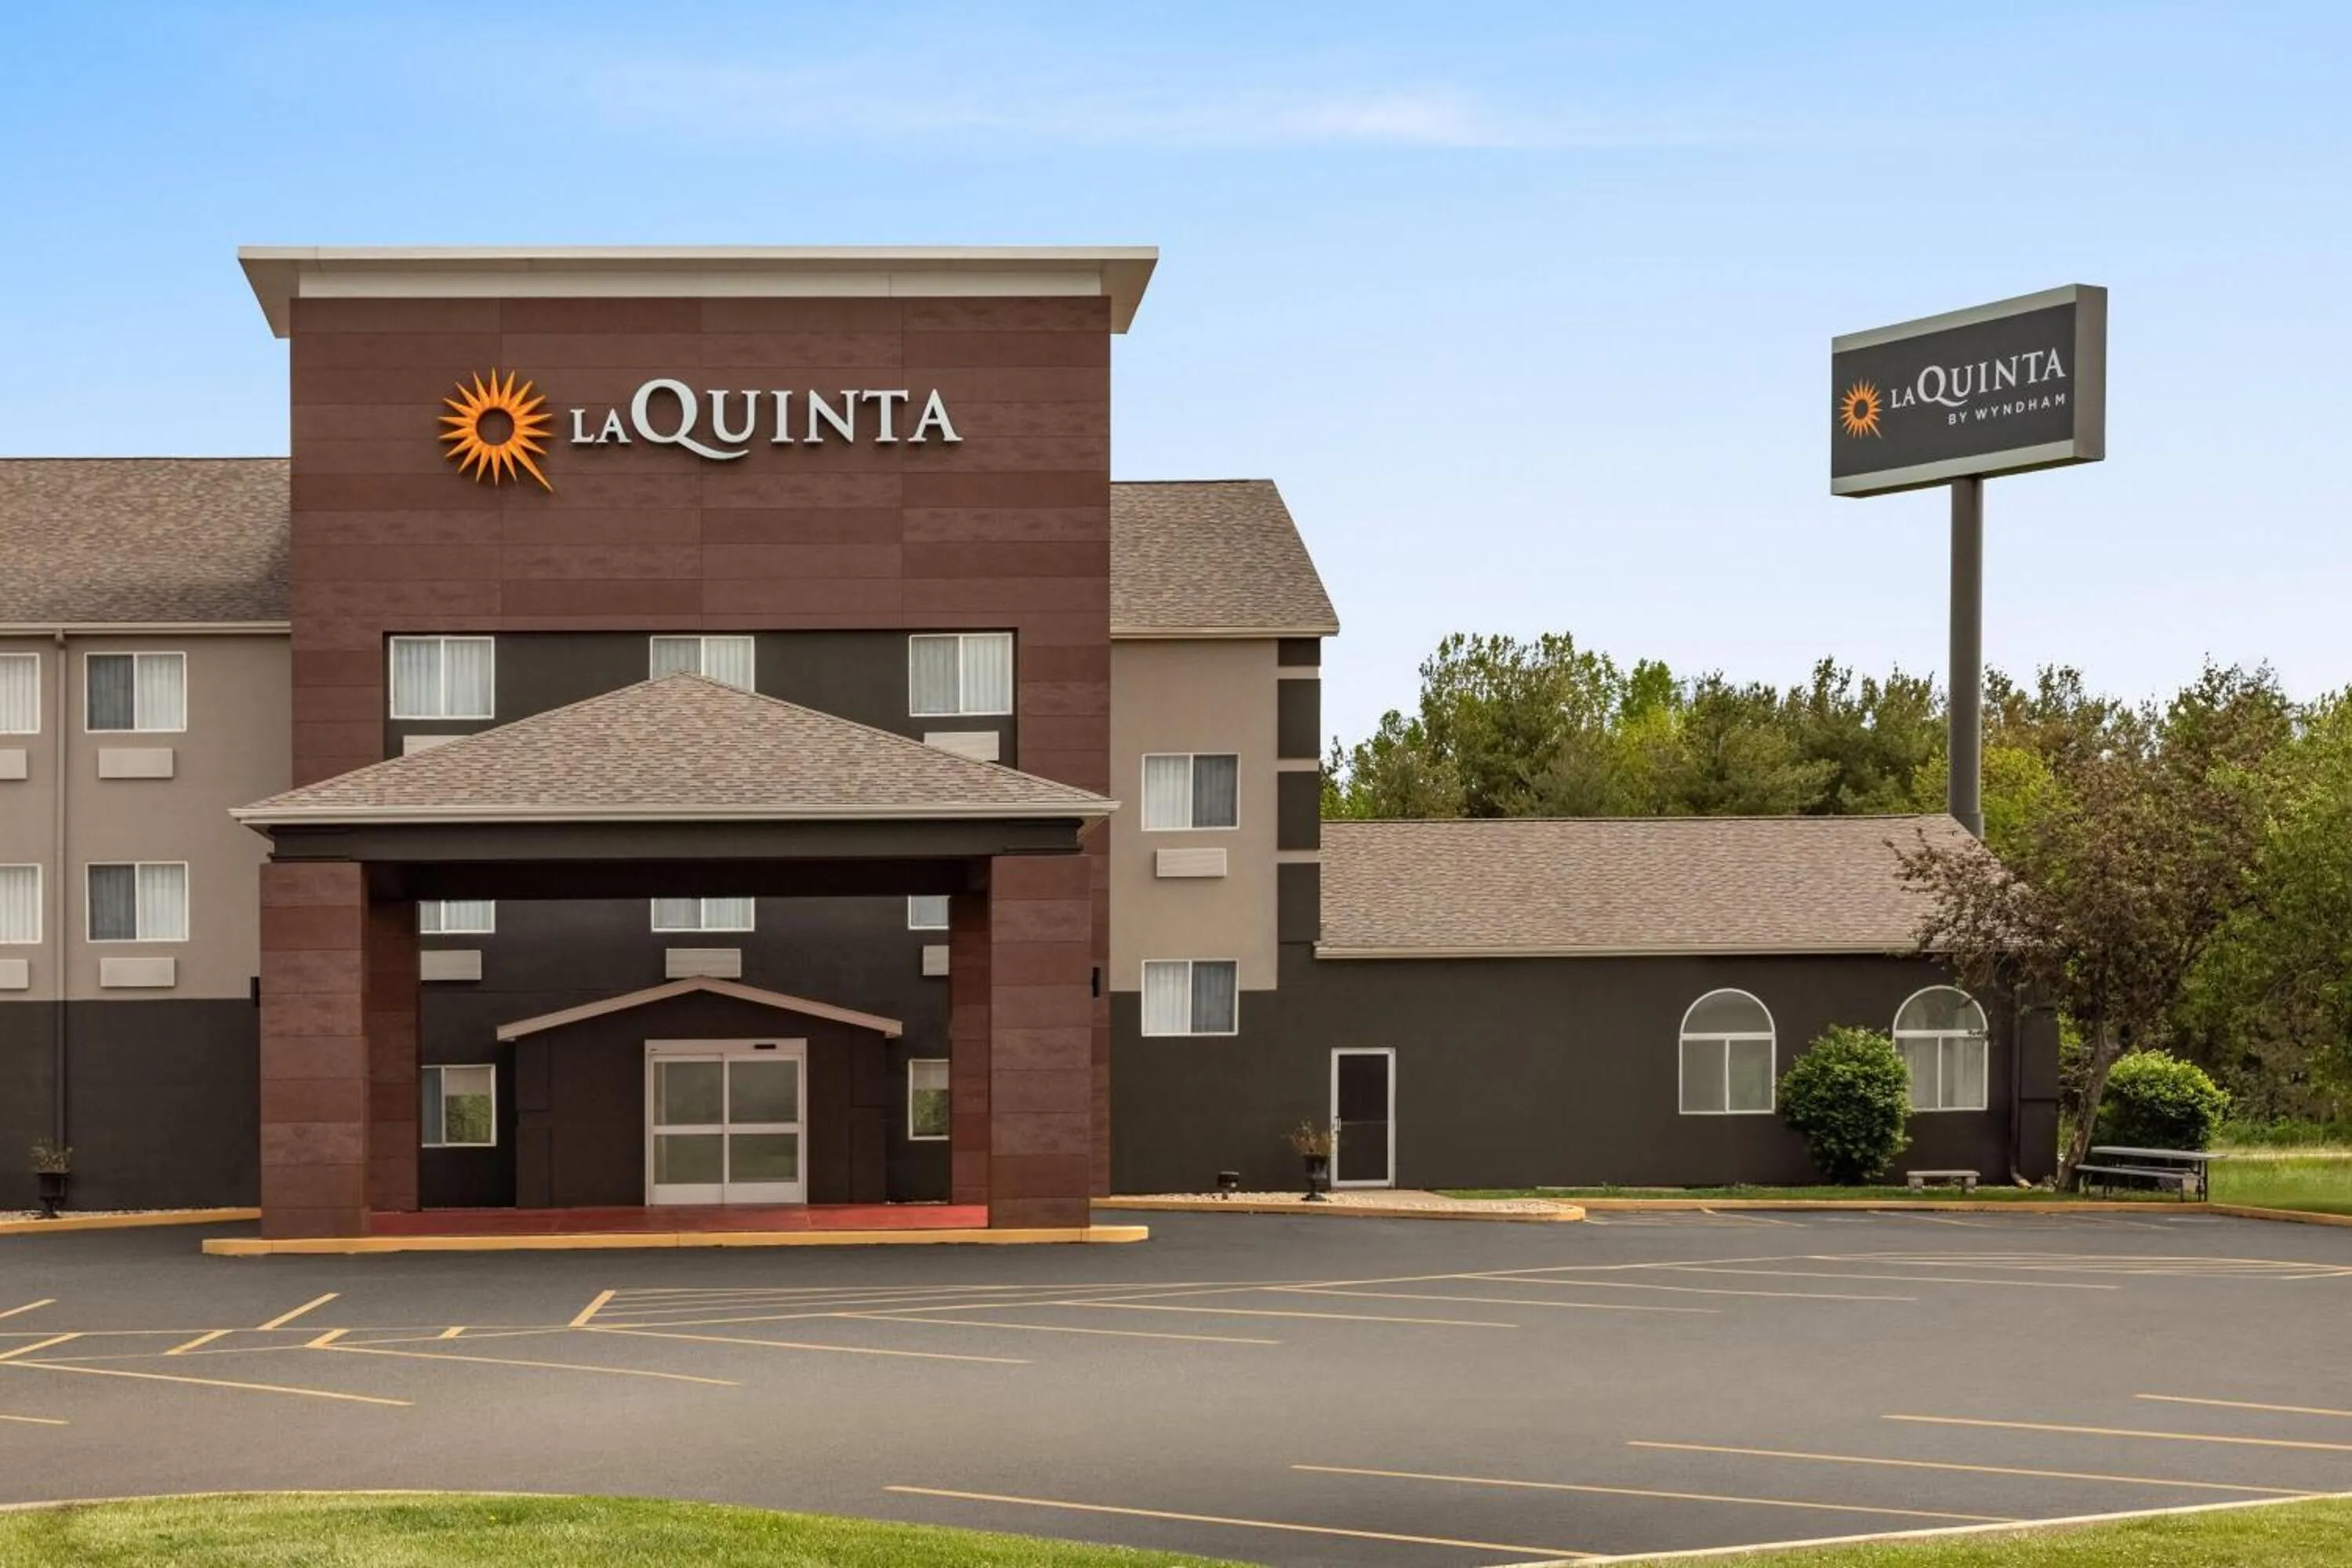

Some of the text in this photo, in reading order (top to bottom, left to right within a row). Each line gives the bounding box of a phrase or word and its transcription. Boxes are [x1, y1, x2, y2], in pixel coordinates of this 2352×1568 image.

[1917, 347, 2067, 407] QUINTA
[630, 378, 964, 460] QUINTA
[1948, 393, 2066, 426] BY WYNDHAM
